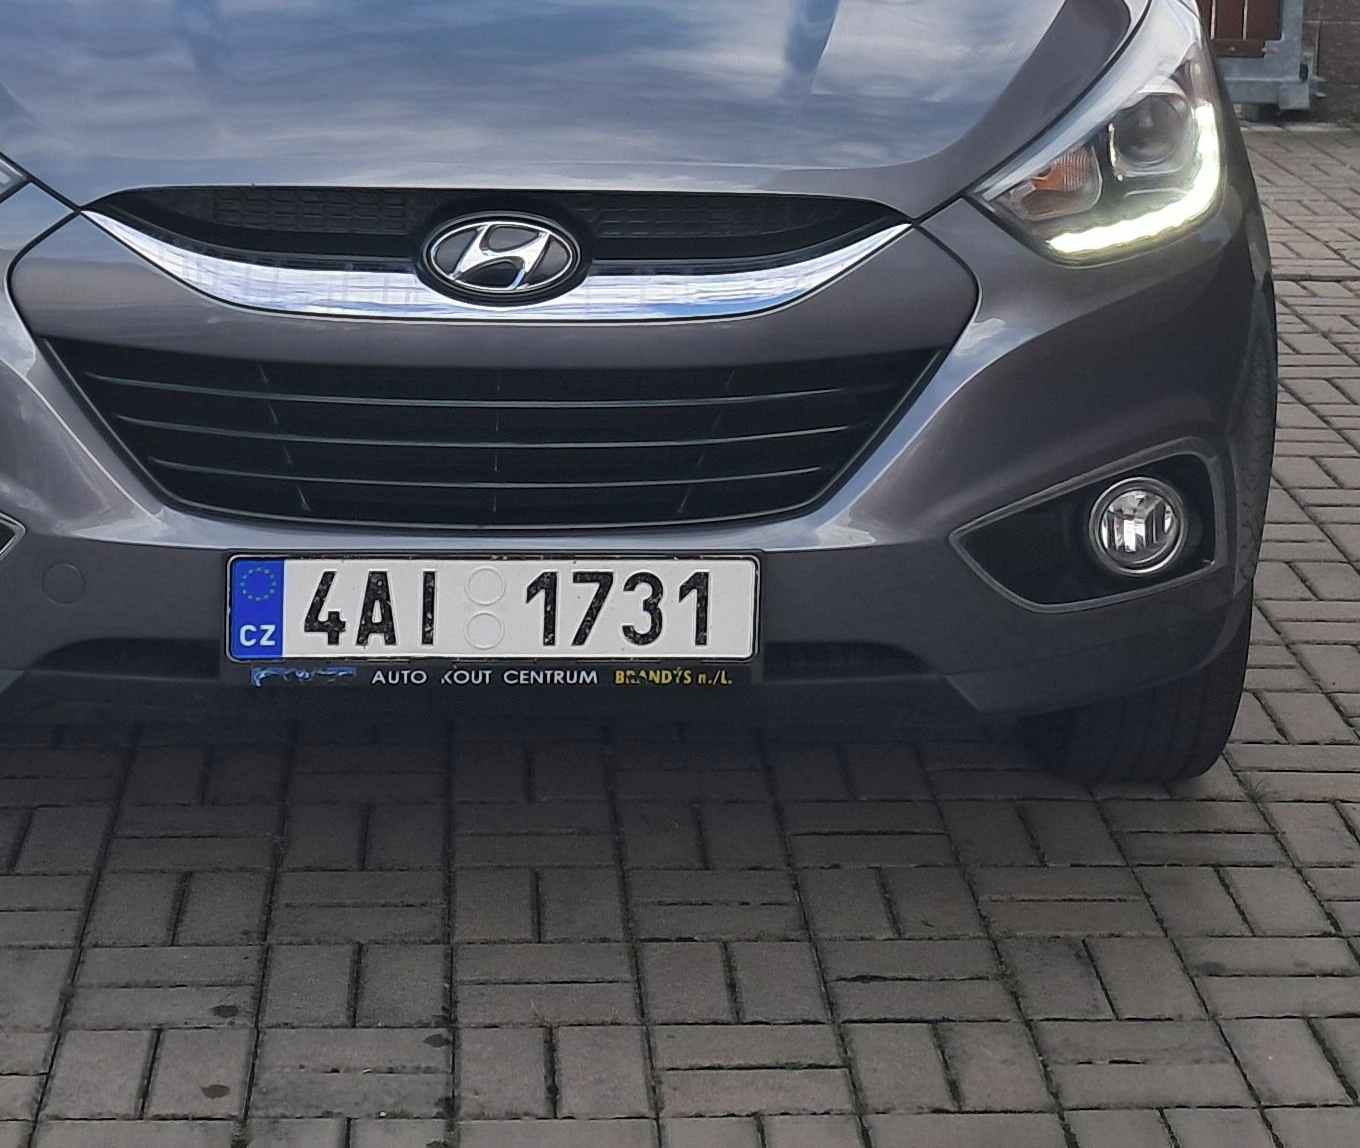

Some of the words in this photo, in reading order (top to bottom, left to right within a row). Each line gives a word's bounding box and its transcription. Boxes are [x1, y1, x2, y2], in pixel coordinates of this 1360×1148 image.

[303, 570, 436, 647] 4AI
[525, 570, 710, 647] 1731
[239, 624, 276, 648] CZ
[371, 669, 428, 685] AUTO
[503, 669, 599, 685] CENTRUM
